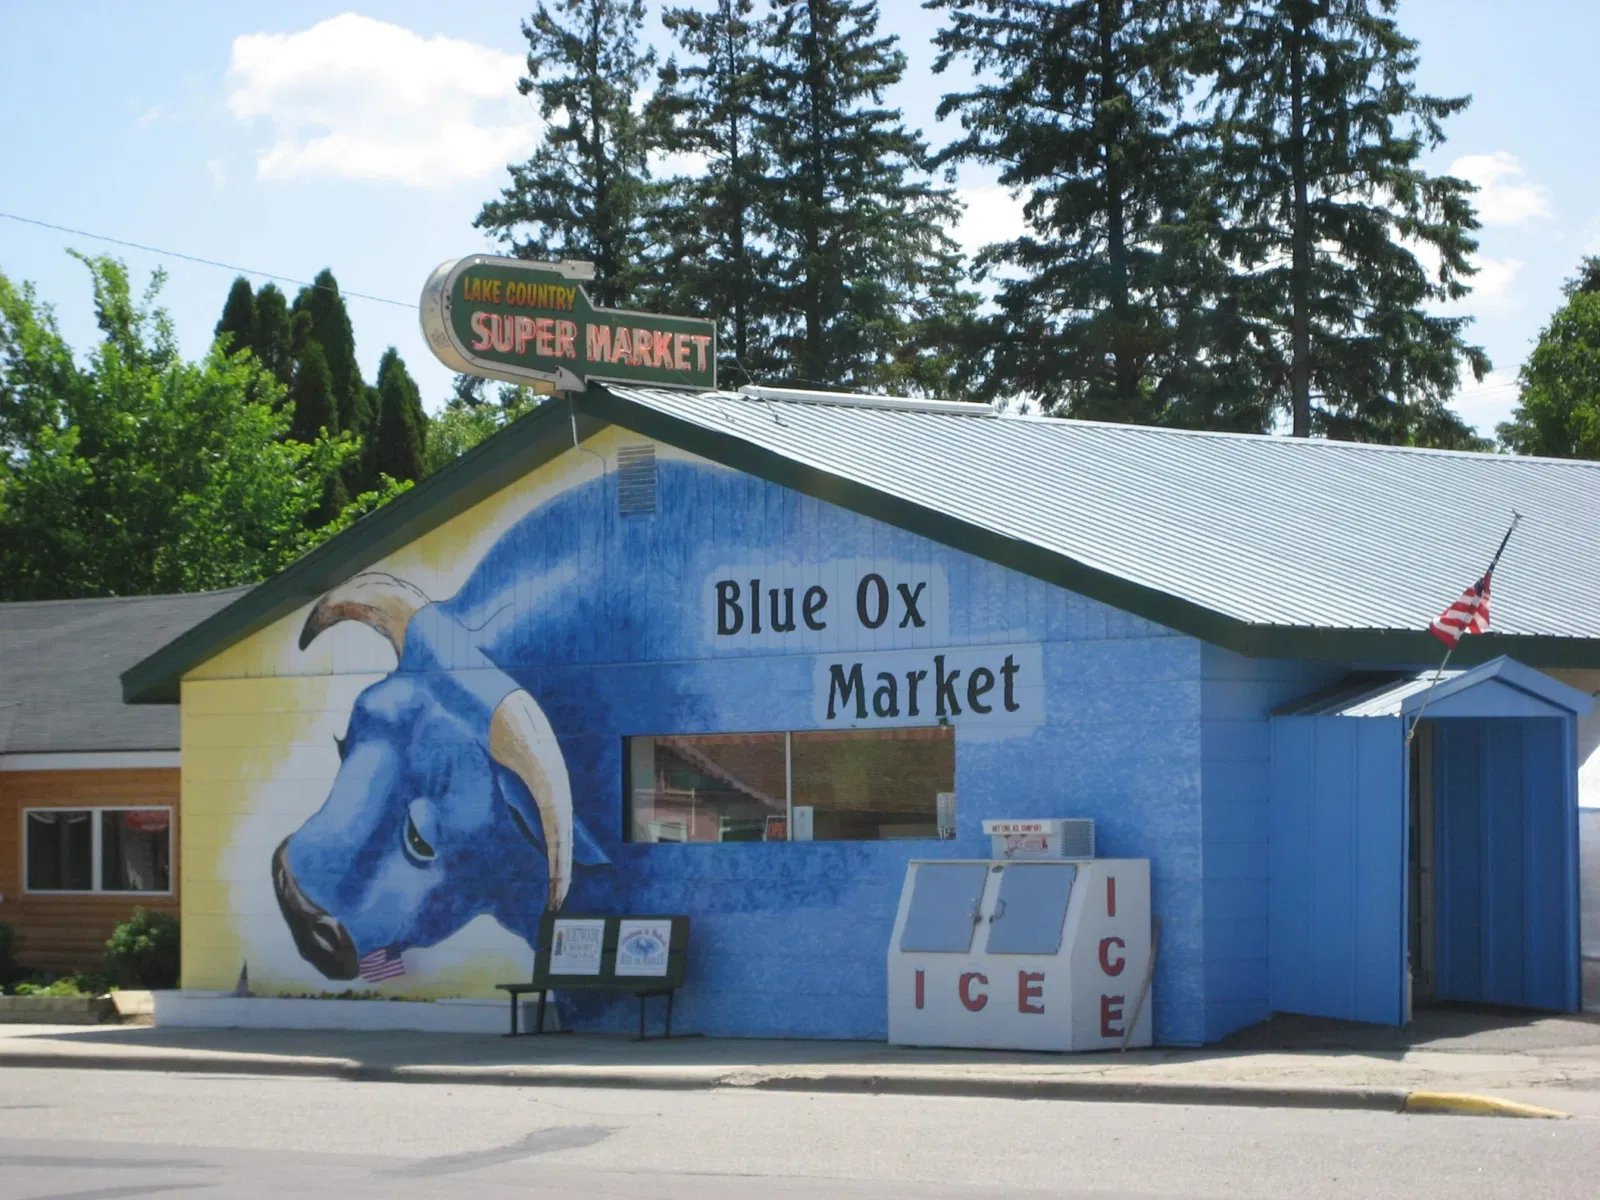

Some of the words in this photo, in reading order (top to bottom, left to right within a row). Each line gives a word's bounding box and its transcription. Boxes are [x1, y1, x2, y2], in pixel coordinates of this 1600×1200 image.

[463, 276, 502, 304] LAKE
[505, 281, 578, 312] COUNTRY
[470, 310, 578, 359] SUPER
[585, 323, 712, 373] MARKET
[715, 579, 828, 636] Blue
[856, 573, 927, 630] Ox
[826, 653, 1020, 720] Market
[1098, 876, 1126, 1038] ICE
[915, 970, 1045, 1014] ICE
